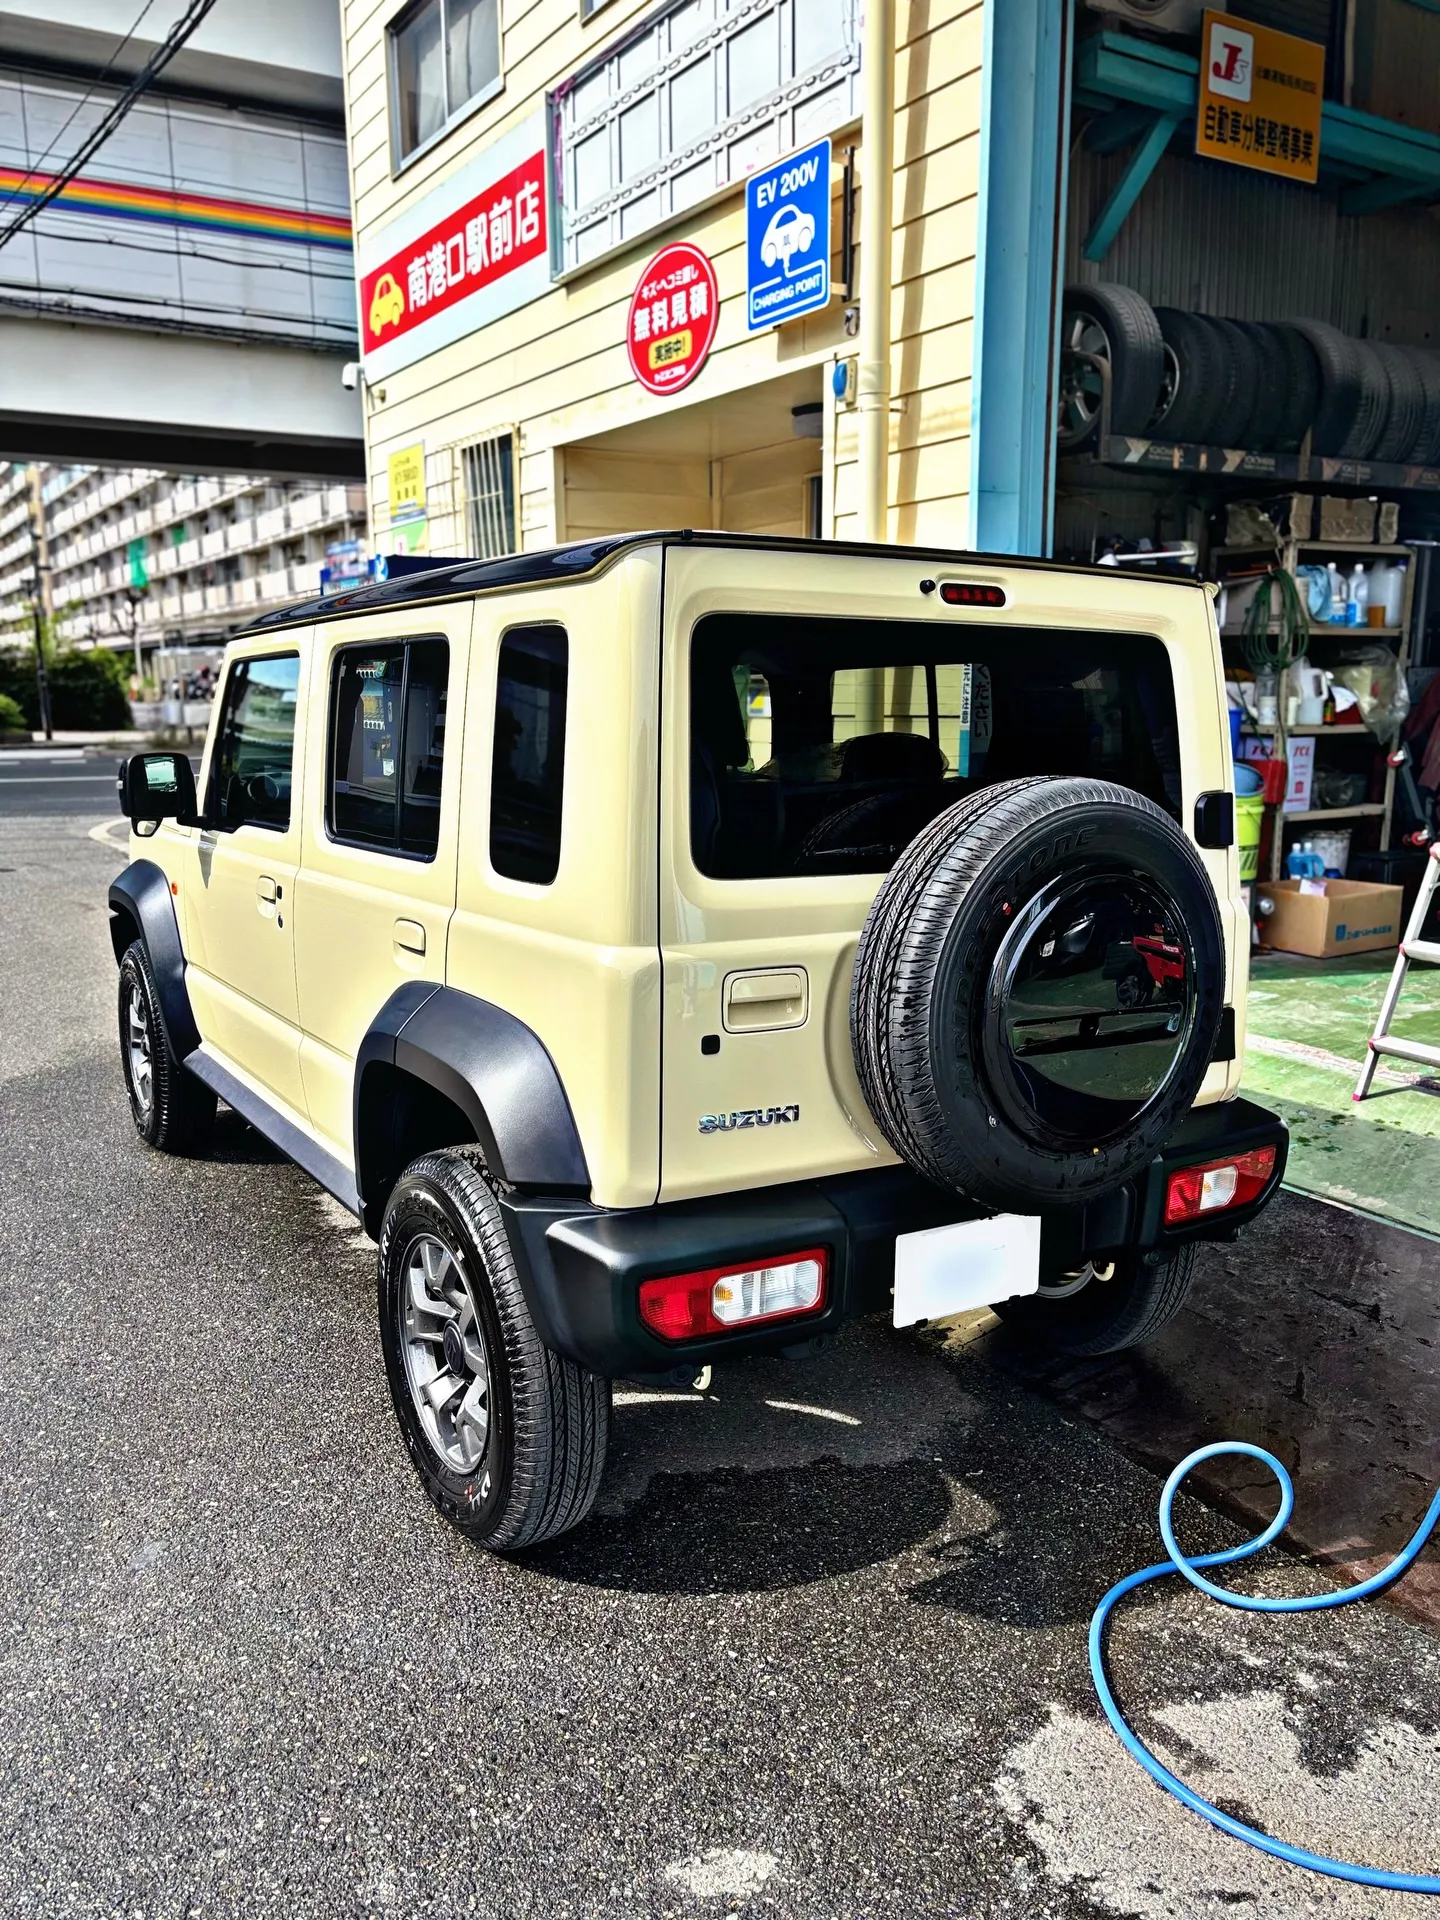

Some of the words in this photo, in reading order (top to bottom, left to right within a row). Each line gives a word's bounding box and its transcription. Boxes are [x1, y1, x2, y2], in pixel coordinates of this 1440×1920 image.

[1204, 103, 1314, 166] 自動車分解整備事業
[756, 177, 778, 209] EV
[780, 156, 819, 198] 200V
[406, 181, 541, 313] 南港口駅前店
[633, 281, 709, 343] 無料見積
[753, 285, 795, 312] CHARGING
[795, 273, 822, 296] POINT
[698, 1104, 800, 1134] SUZUKI
